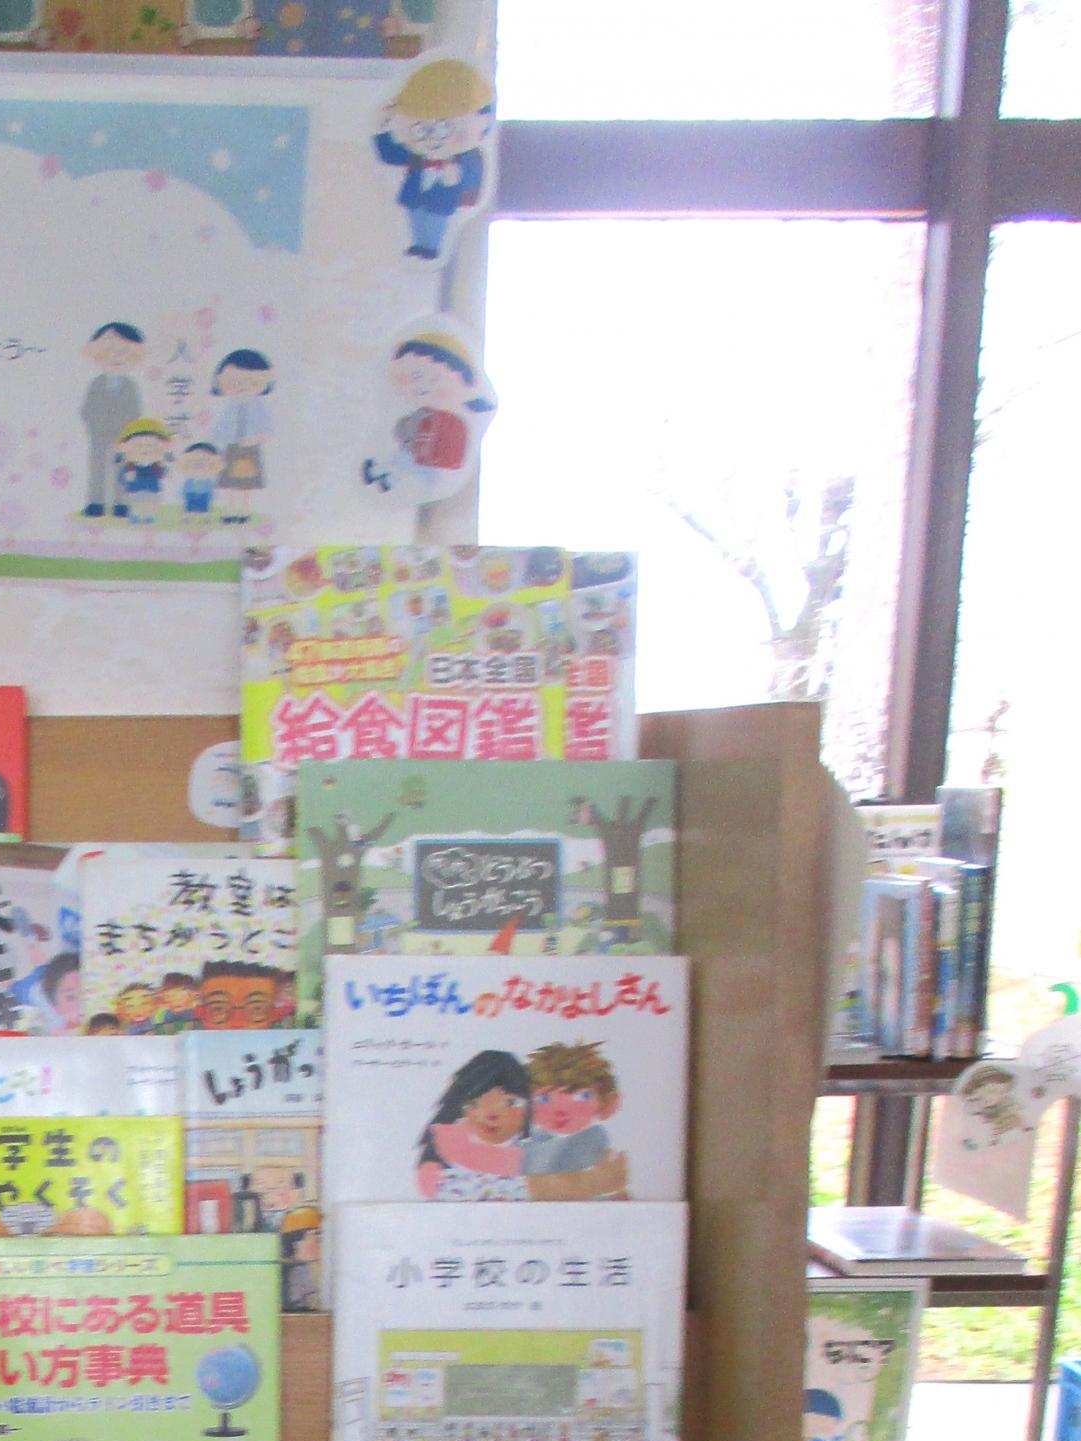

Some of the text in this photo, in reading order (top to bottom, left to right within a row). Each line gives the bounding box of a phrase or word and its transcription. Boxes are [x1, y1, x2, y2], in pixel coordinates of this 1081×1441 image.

[274, 693, 537, 765] 給食図鑑
[345, 972, 672, 1019] いちばんのなかよしさん
[204, 1036, 325, 1106] しょうがっ
[385, 1255, 634, 1289] 小学校の生活
